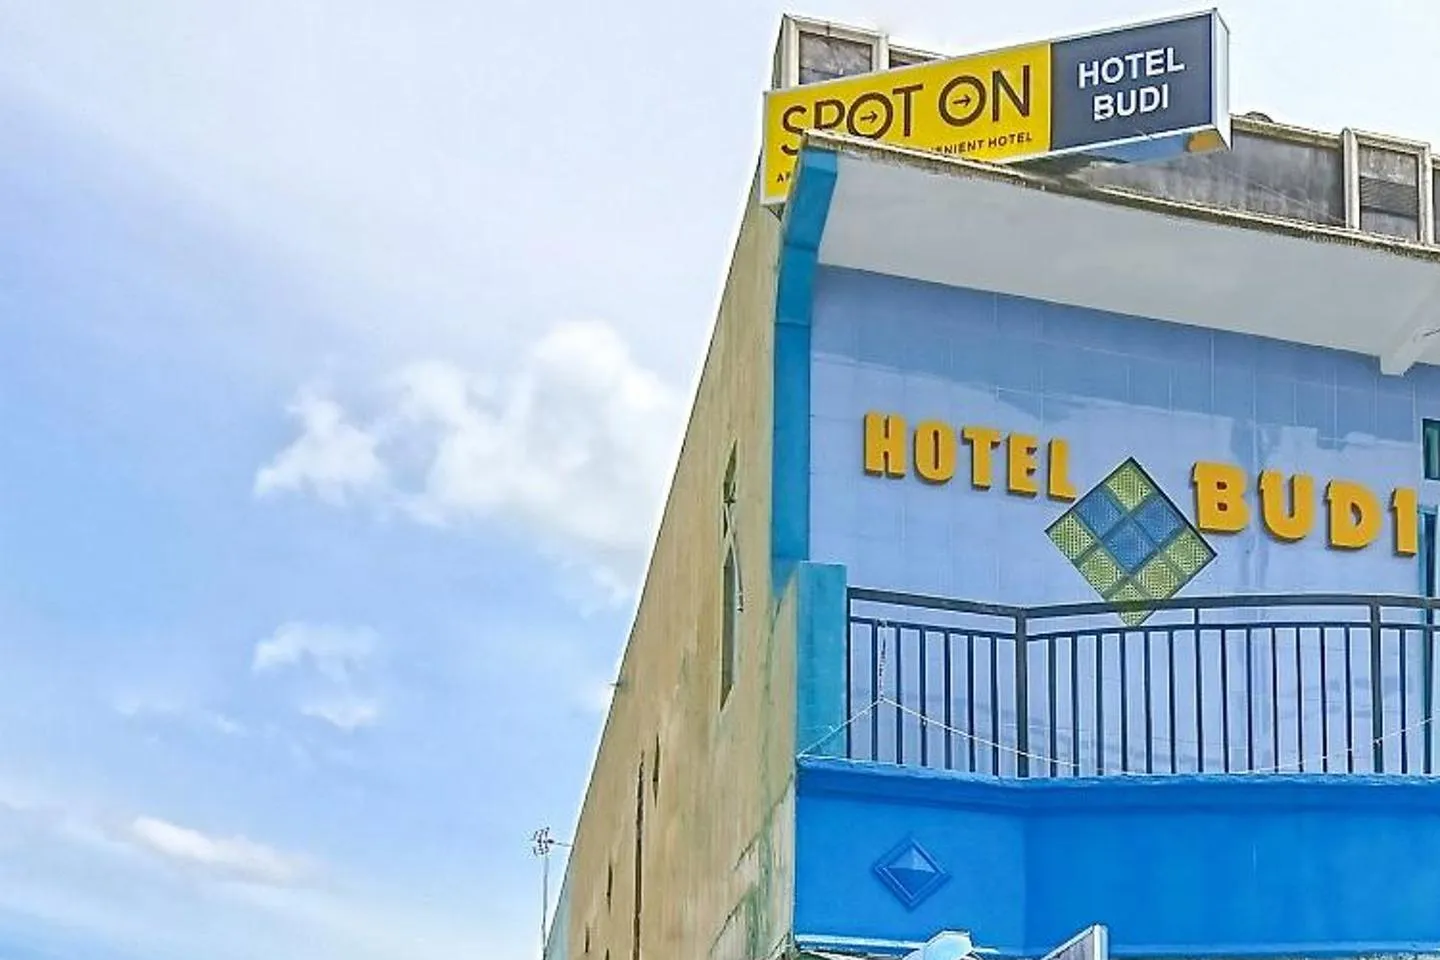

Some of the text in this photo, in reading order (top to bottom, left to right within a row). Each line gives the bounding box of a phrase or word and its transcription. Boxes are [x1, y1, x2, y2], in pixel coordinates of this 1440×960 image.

[1078, 47, 1186, 89] HOTEL
[781, 64, 1031, 157] SPOT ON
[1092, 83, 1170, 122] BUDI
[988, 132, 1033, 148] HOTEL
[863, 410, 1419, 557] HOTEL BUDI
